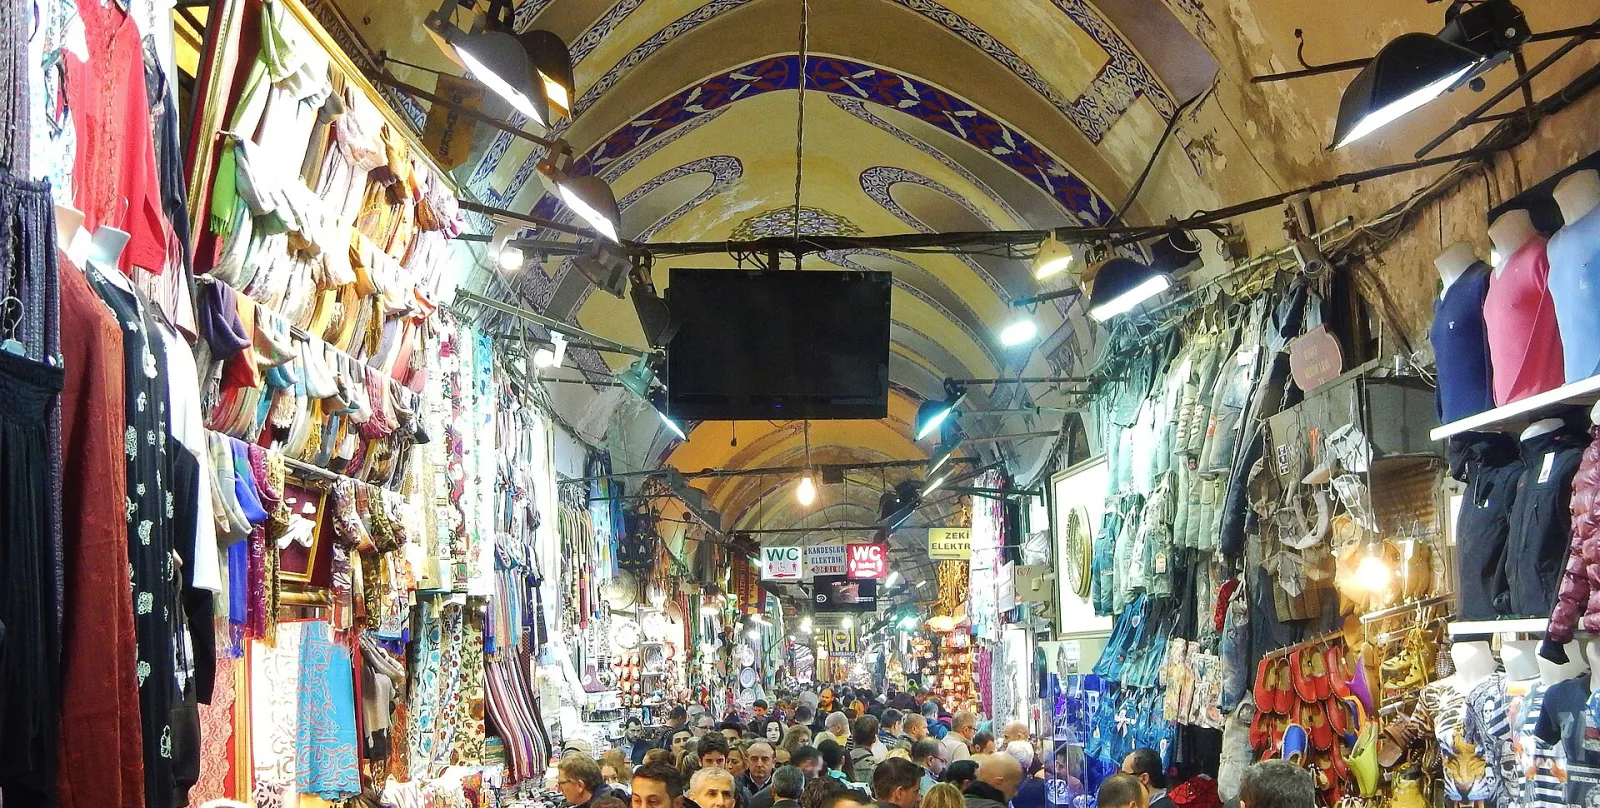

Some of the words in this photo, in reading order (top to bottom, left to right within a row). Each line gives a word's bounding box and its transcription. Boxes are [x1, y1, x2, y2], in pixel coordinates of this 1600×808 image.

[945, 530, 969, 540] ZEKİ
[766, 547, 799, 561] WC
[852, 545, 881, 561] WC
